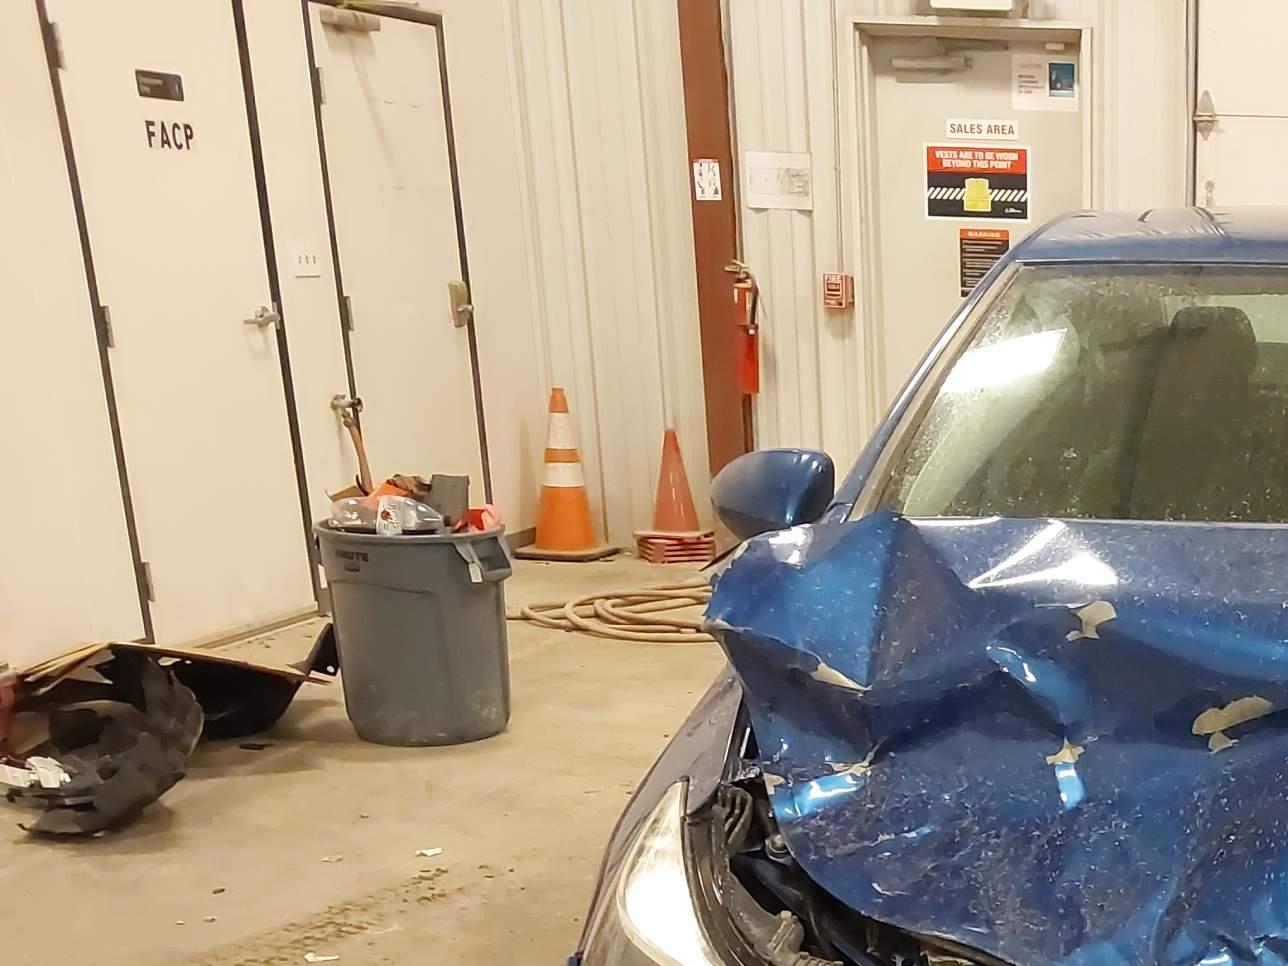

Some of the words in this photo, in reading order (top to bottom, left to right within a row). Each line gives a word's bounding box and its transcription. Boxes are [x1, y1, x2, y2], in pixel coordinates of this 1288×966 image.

[950, 123, 983, 134] SALES
[986, 124, 1014, 135] AREA
[144, 120, 194, 150] FACP
[935, 150, 958, 159] VESTS
[959, 151, 973, 160] ARE
[974, 152, 984, 160] TO
[995, 152, 1019, 161] WORN
[942, 159, 972, 168] BEYOND
[972, 160, 989, 169] THIS
[989, 160, 1012, 169] POINT
